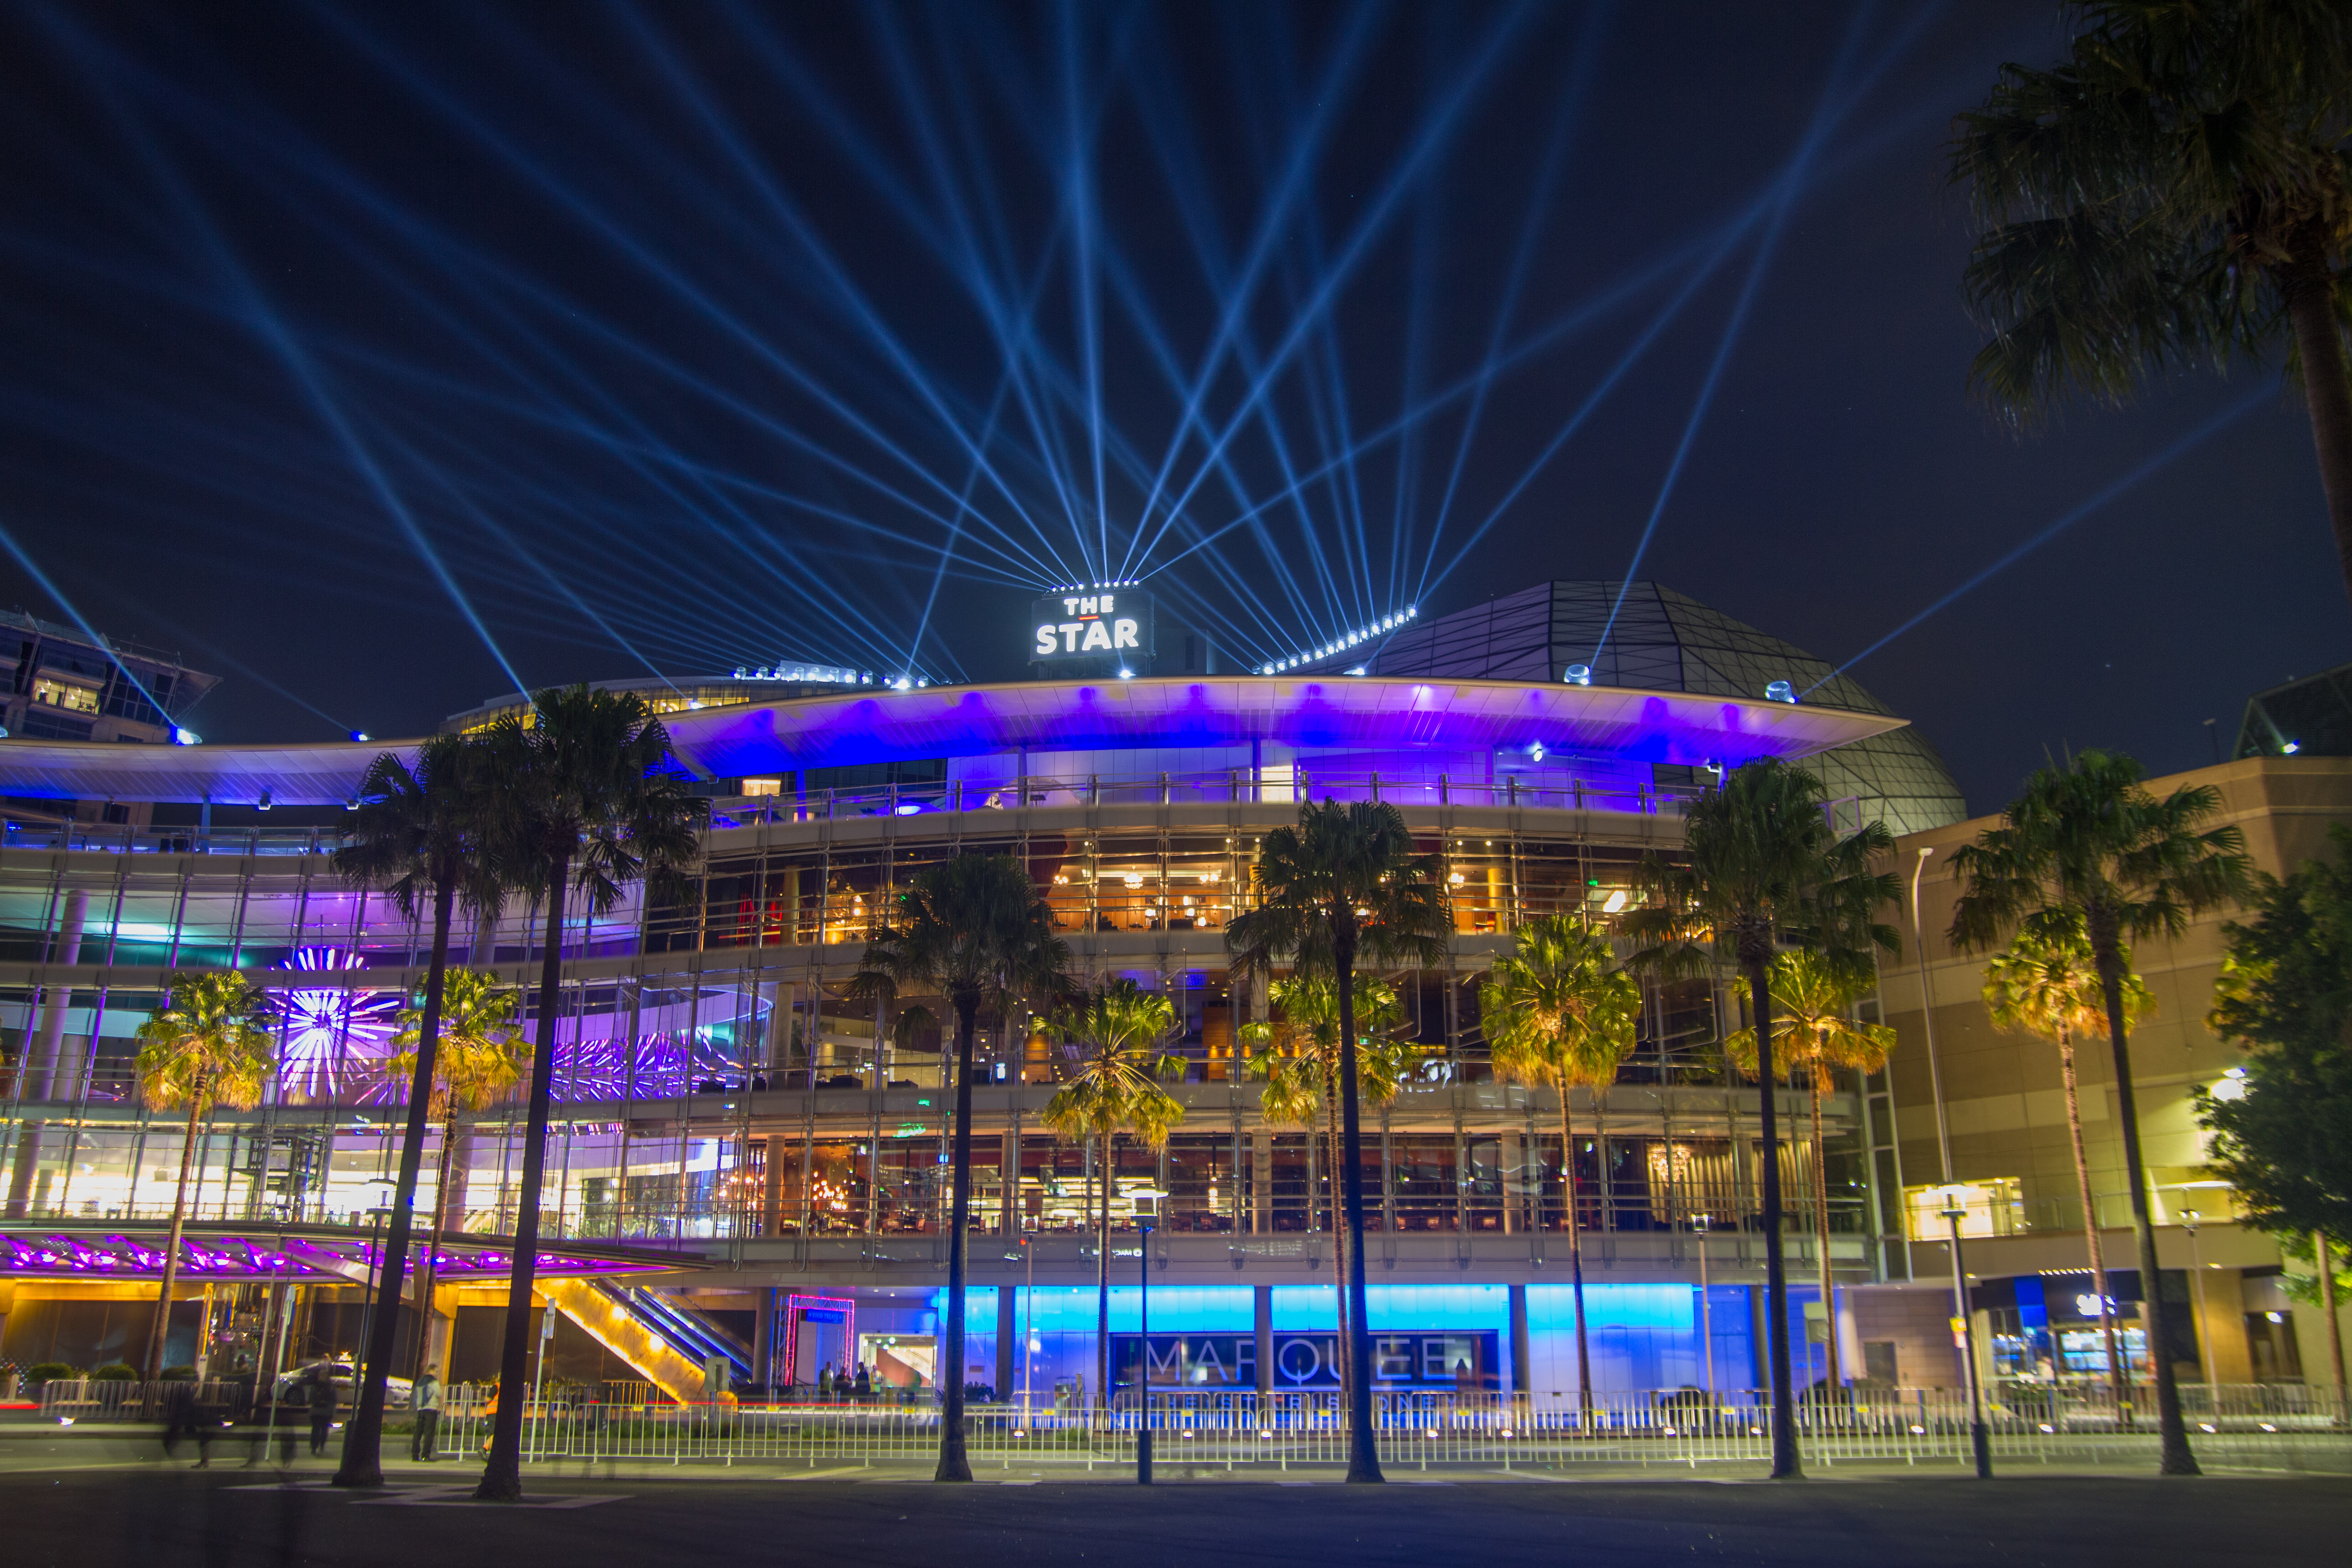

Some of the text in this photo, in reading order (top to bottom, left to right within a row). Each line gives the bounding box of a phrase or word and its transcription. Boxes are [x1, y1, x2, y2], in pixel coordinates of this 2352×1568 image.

[1064, 595, 1113, 615] THE
[1037, 619, 1139, 654] STAR
[1220, 1397, 1301, 1410] STR
[1327, 1396, 1458, 1410] SDNEY
